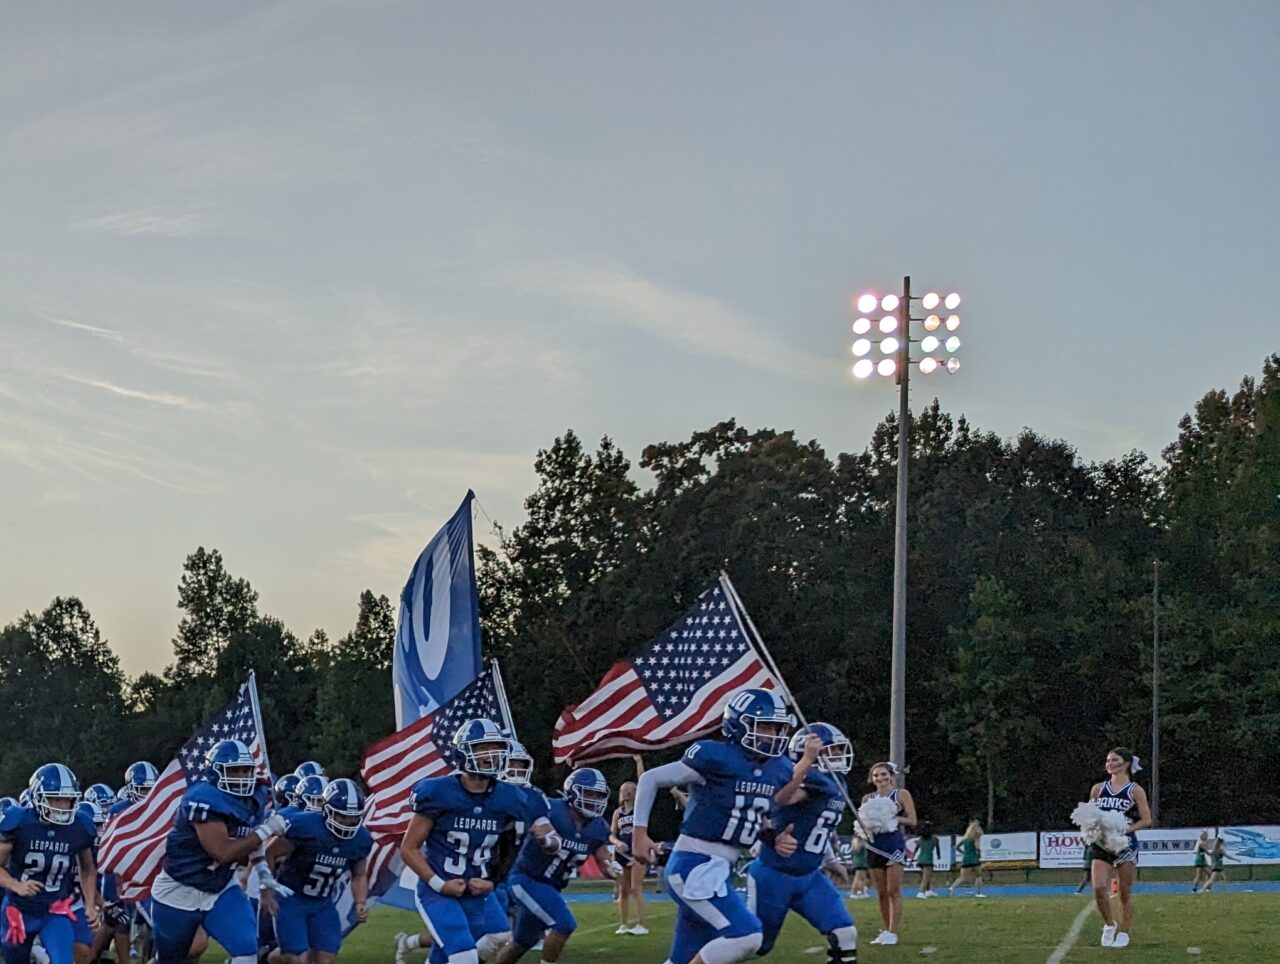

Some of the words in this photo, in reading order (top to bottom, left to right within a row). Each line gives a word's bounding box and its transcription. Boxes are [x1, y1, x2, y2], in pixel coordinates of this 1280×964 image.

[732, 692, 755, 712] 10
[735, 781, 775, 796] LEOPARDS
[188, 801, 210, 821] 77
[722, 795, 770, 845] 10
[454, 817, 497, 831] LEOPARDS
[30, 840, 69, 853] LEOPARDS
[443, 831, 499, 878] 34
[316, 853, 347, 866] LEOPARDS
[21, 852, 69, 892] 20
